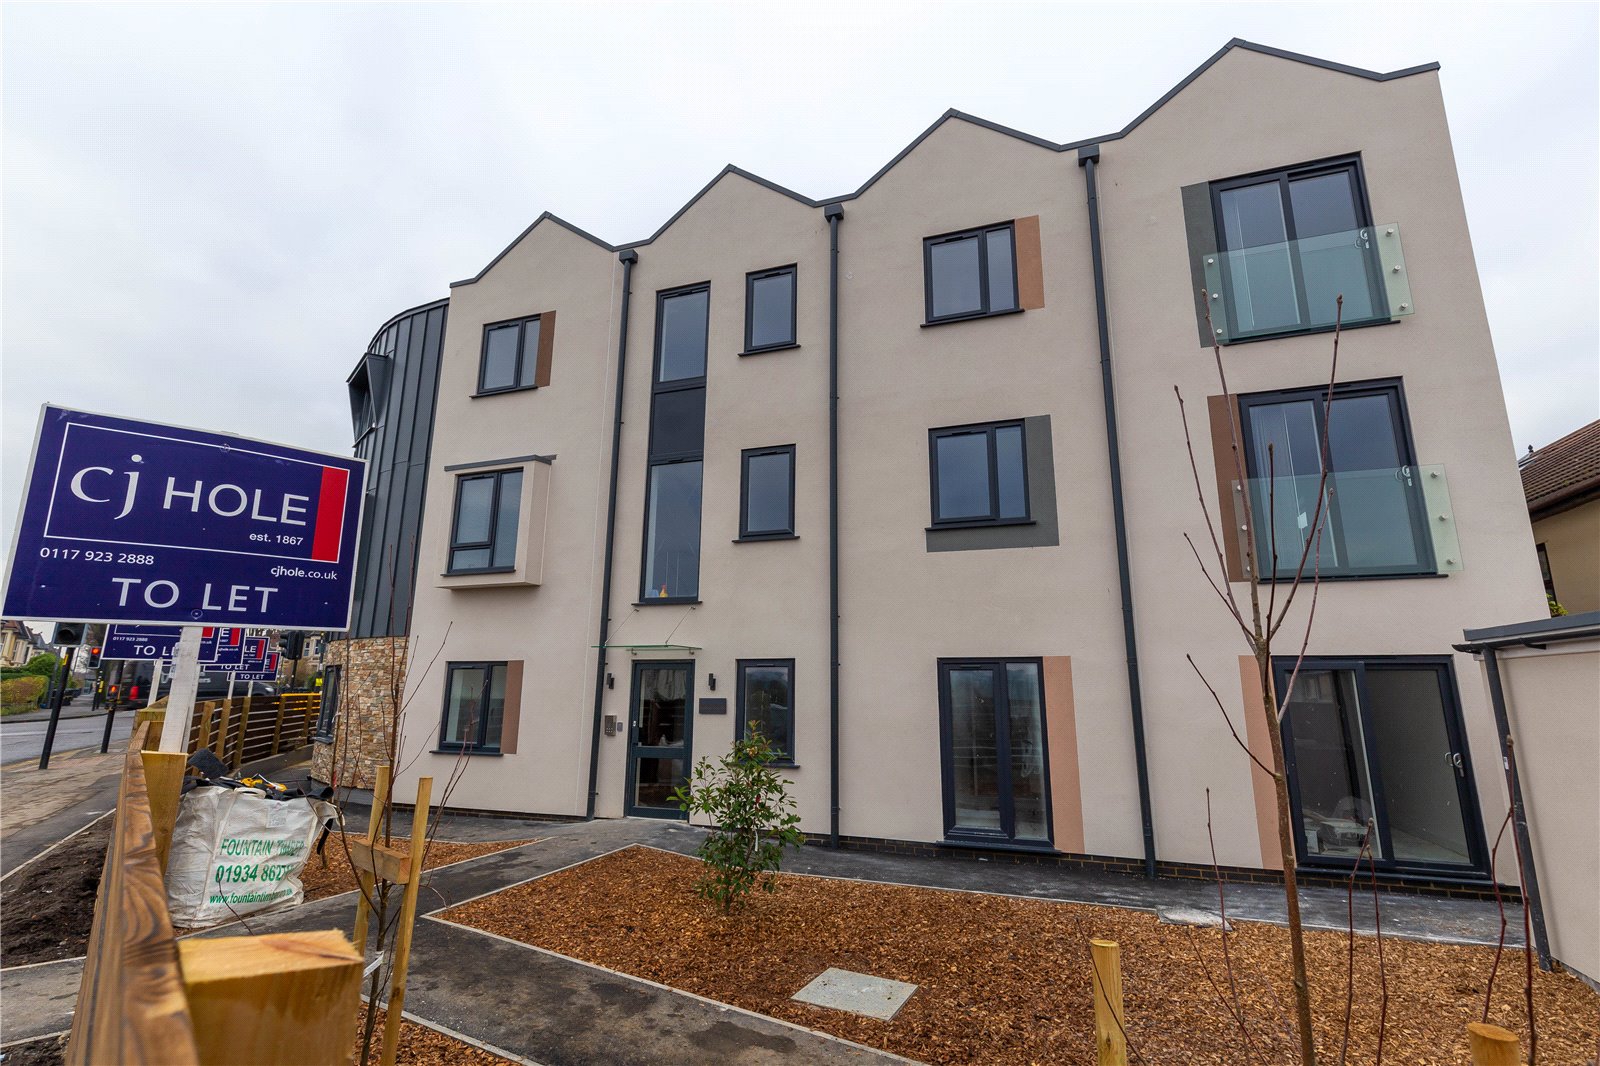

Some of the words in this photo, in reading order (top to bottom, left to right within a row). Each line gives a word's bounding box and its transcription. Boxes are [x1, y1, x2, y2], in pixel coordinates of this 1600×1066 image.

[163, 476, 310, 527] HOLE
[249, 533, 271, 543] est.
[276, 534, 304, 546] 1867
[39, 547, 80, 560] 0117
[84, 550, 113, 562] 923
[117, 553, 154, 565] 2888
[270, 565, 338, 580] cjhole.co.uk
[111, 577, 180, 609] TO
[201, 583, 279, 613] LET
[133, 645, 156, 656] TO
[220, 838, 274, 857] FOUNTAIN
[215, 864, 259, 883] 01934
